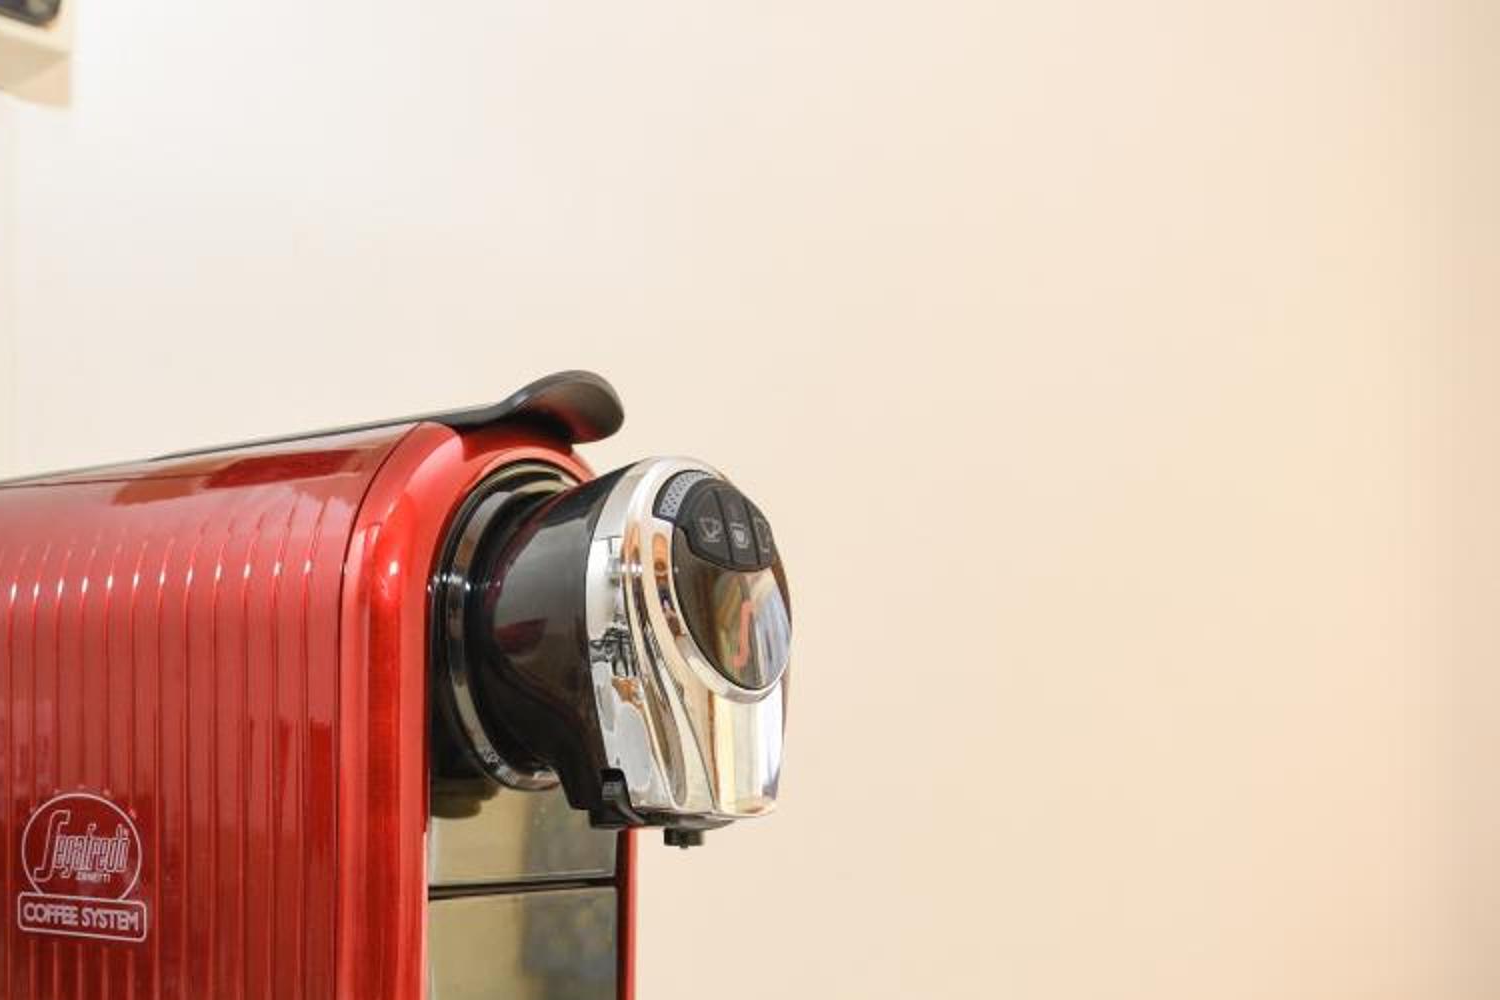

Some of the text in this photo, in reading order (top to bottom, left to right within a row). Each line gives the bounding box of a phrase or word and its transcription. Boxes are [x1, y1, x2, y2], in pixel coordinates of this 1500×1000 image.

[34, 809, 131, 883] Segafredo
[23, 902, 140, 932] COFFEE SYSTEM
